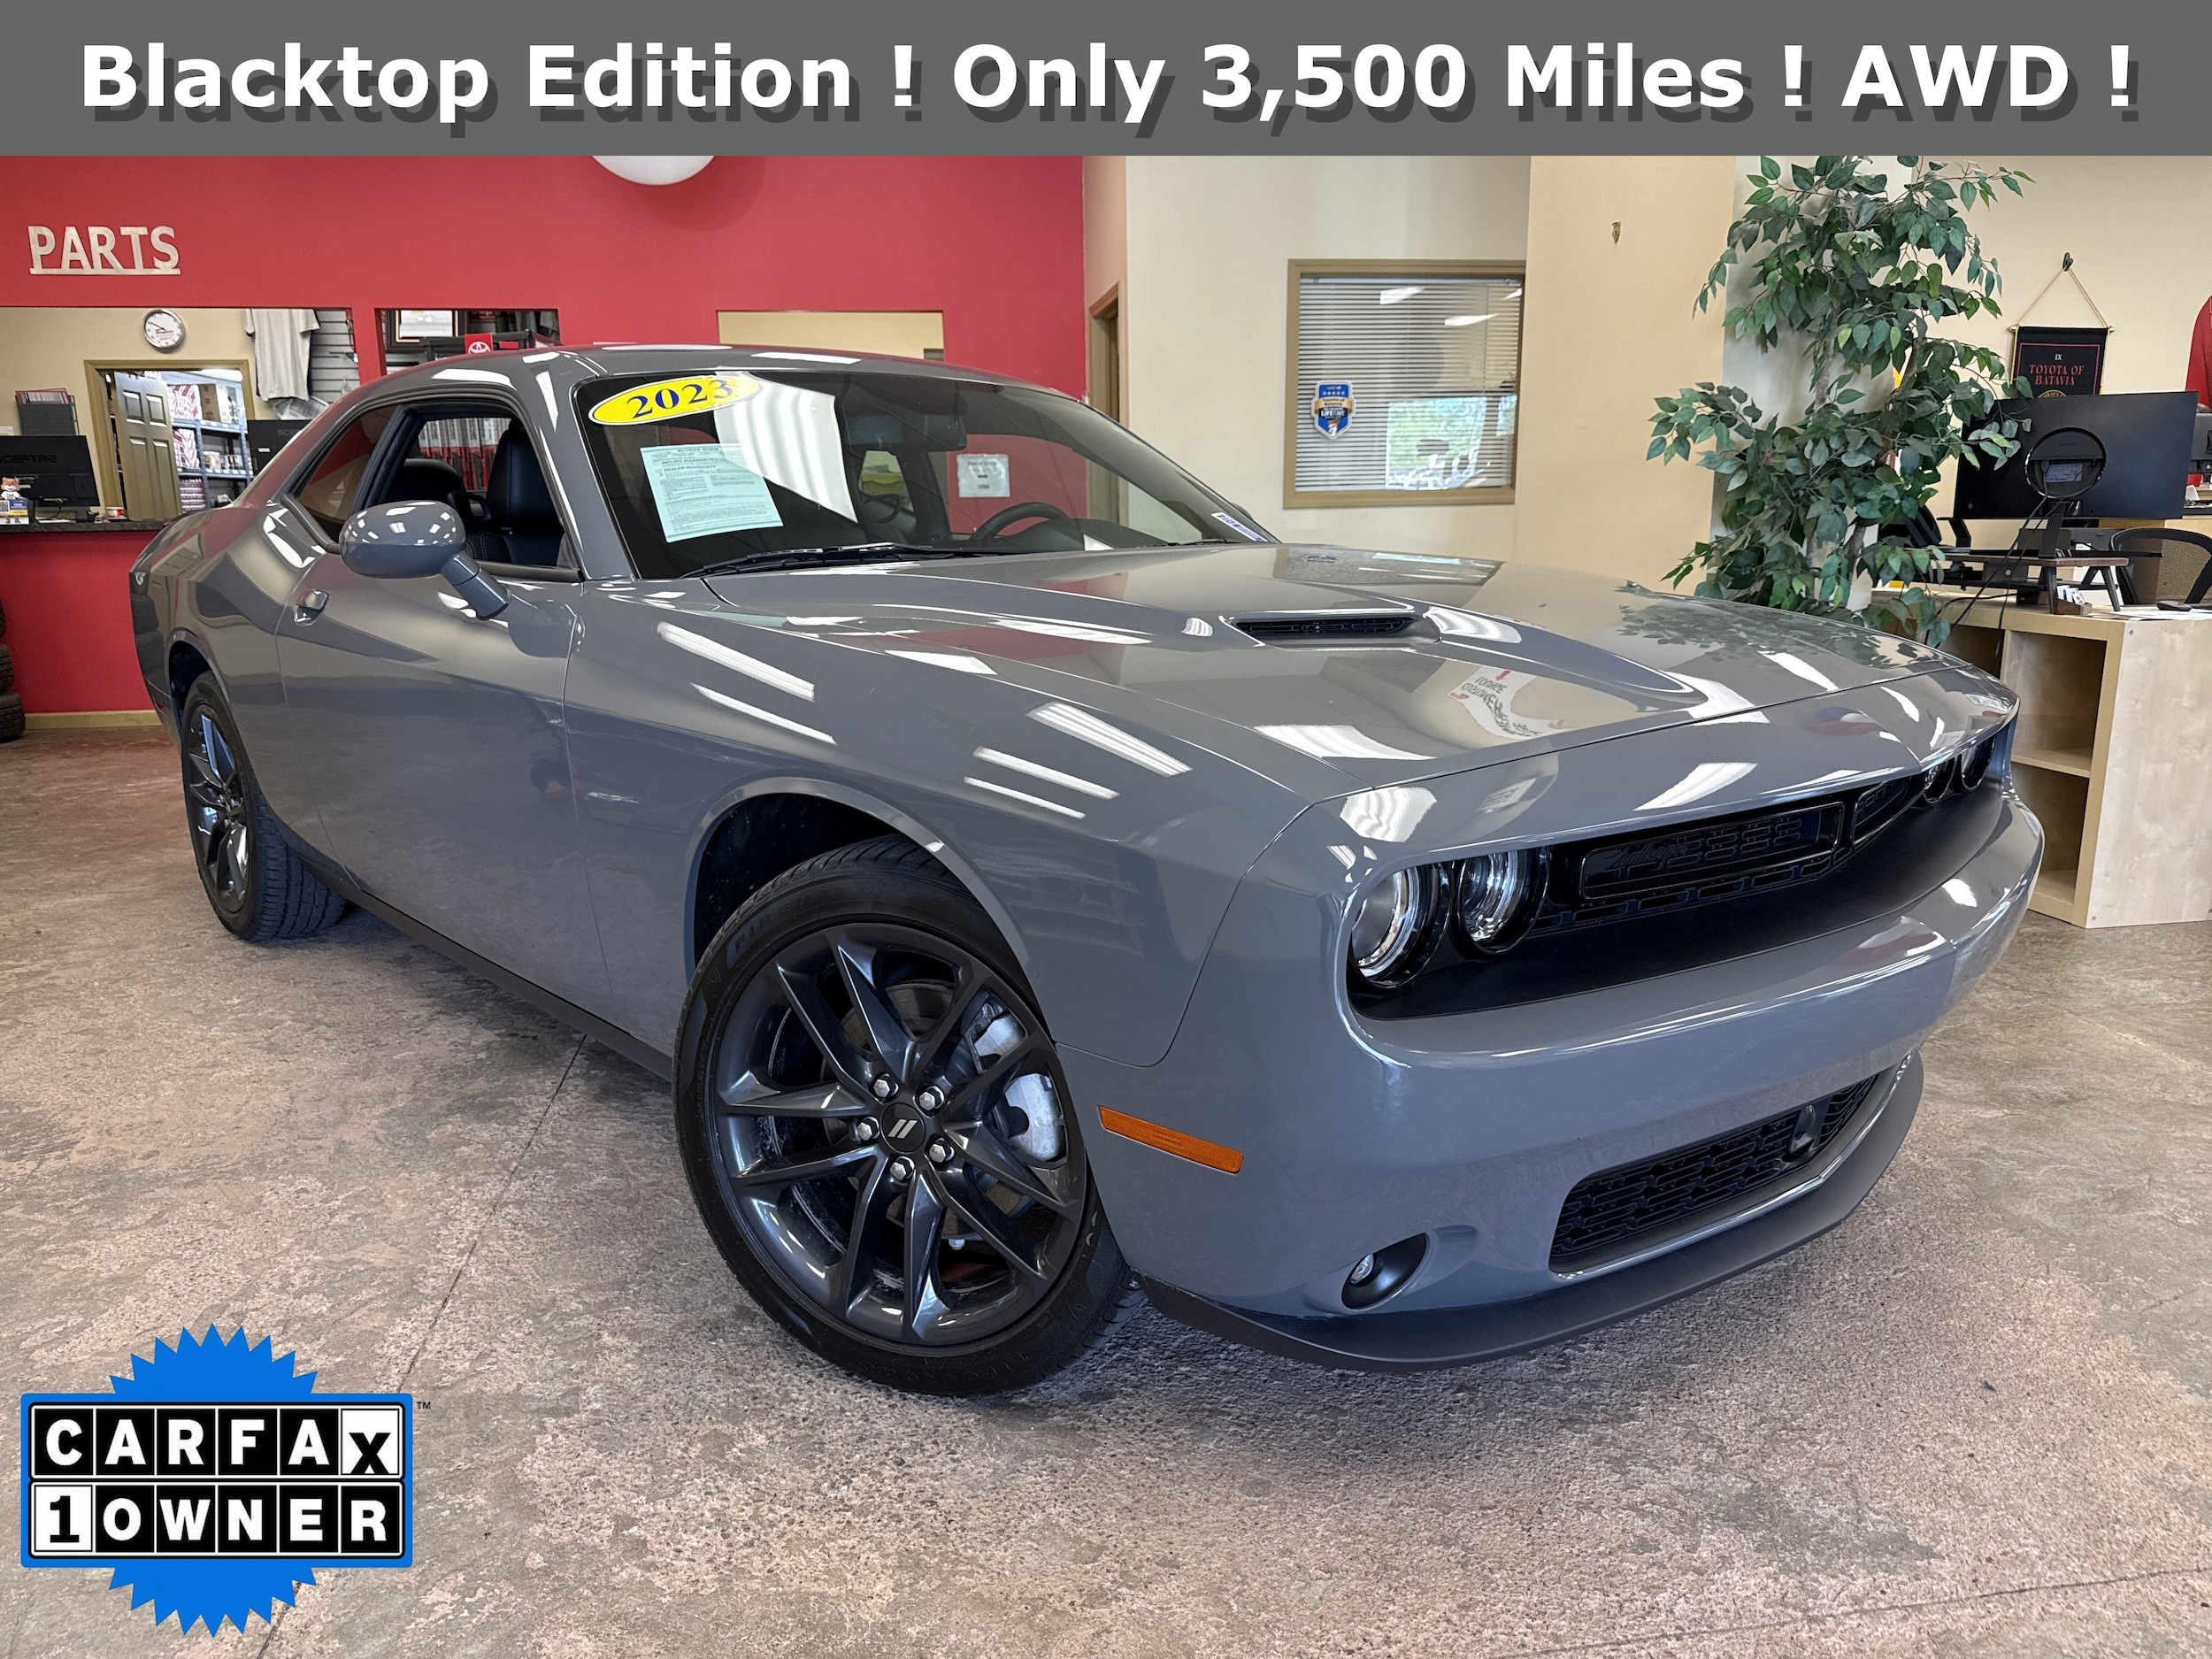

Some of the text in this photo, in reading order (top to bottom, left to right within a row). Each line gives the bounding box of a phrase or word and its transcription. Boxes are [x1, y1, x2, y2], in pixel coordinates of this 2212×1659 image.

[27, 226, 180, 272] PARTS
[2029, 364, 2085, 375] TOYOTA OF
[2034, 375, 2076, 386] BATAVIA
[626, 379, 733, 419] 2023
[0, 454, 58, 463] CEPTRE
[733, 883, 882, 951] FIREHAWK
